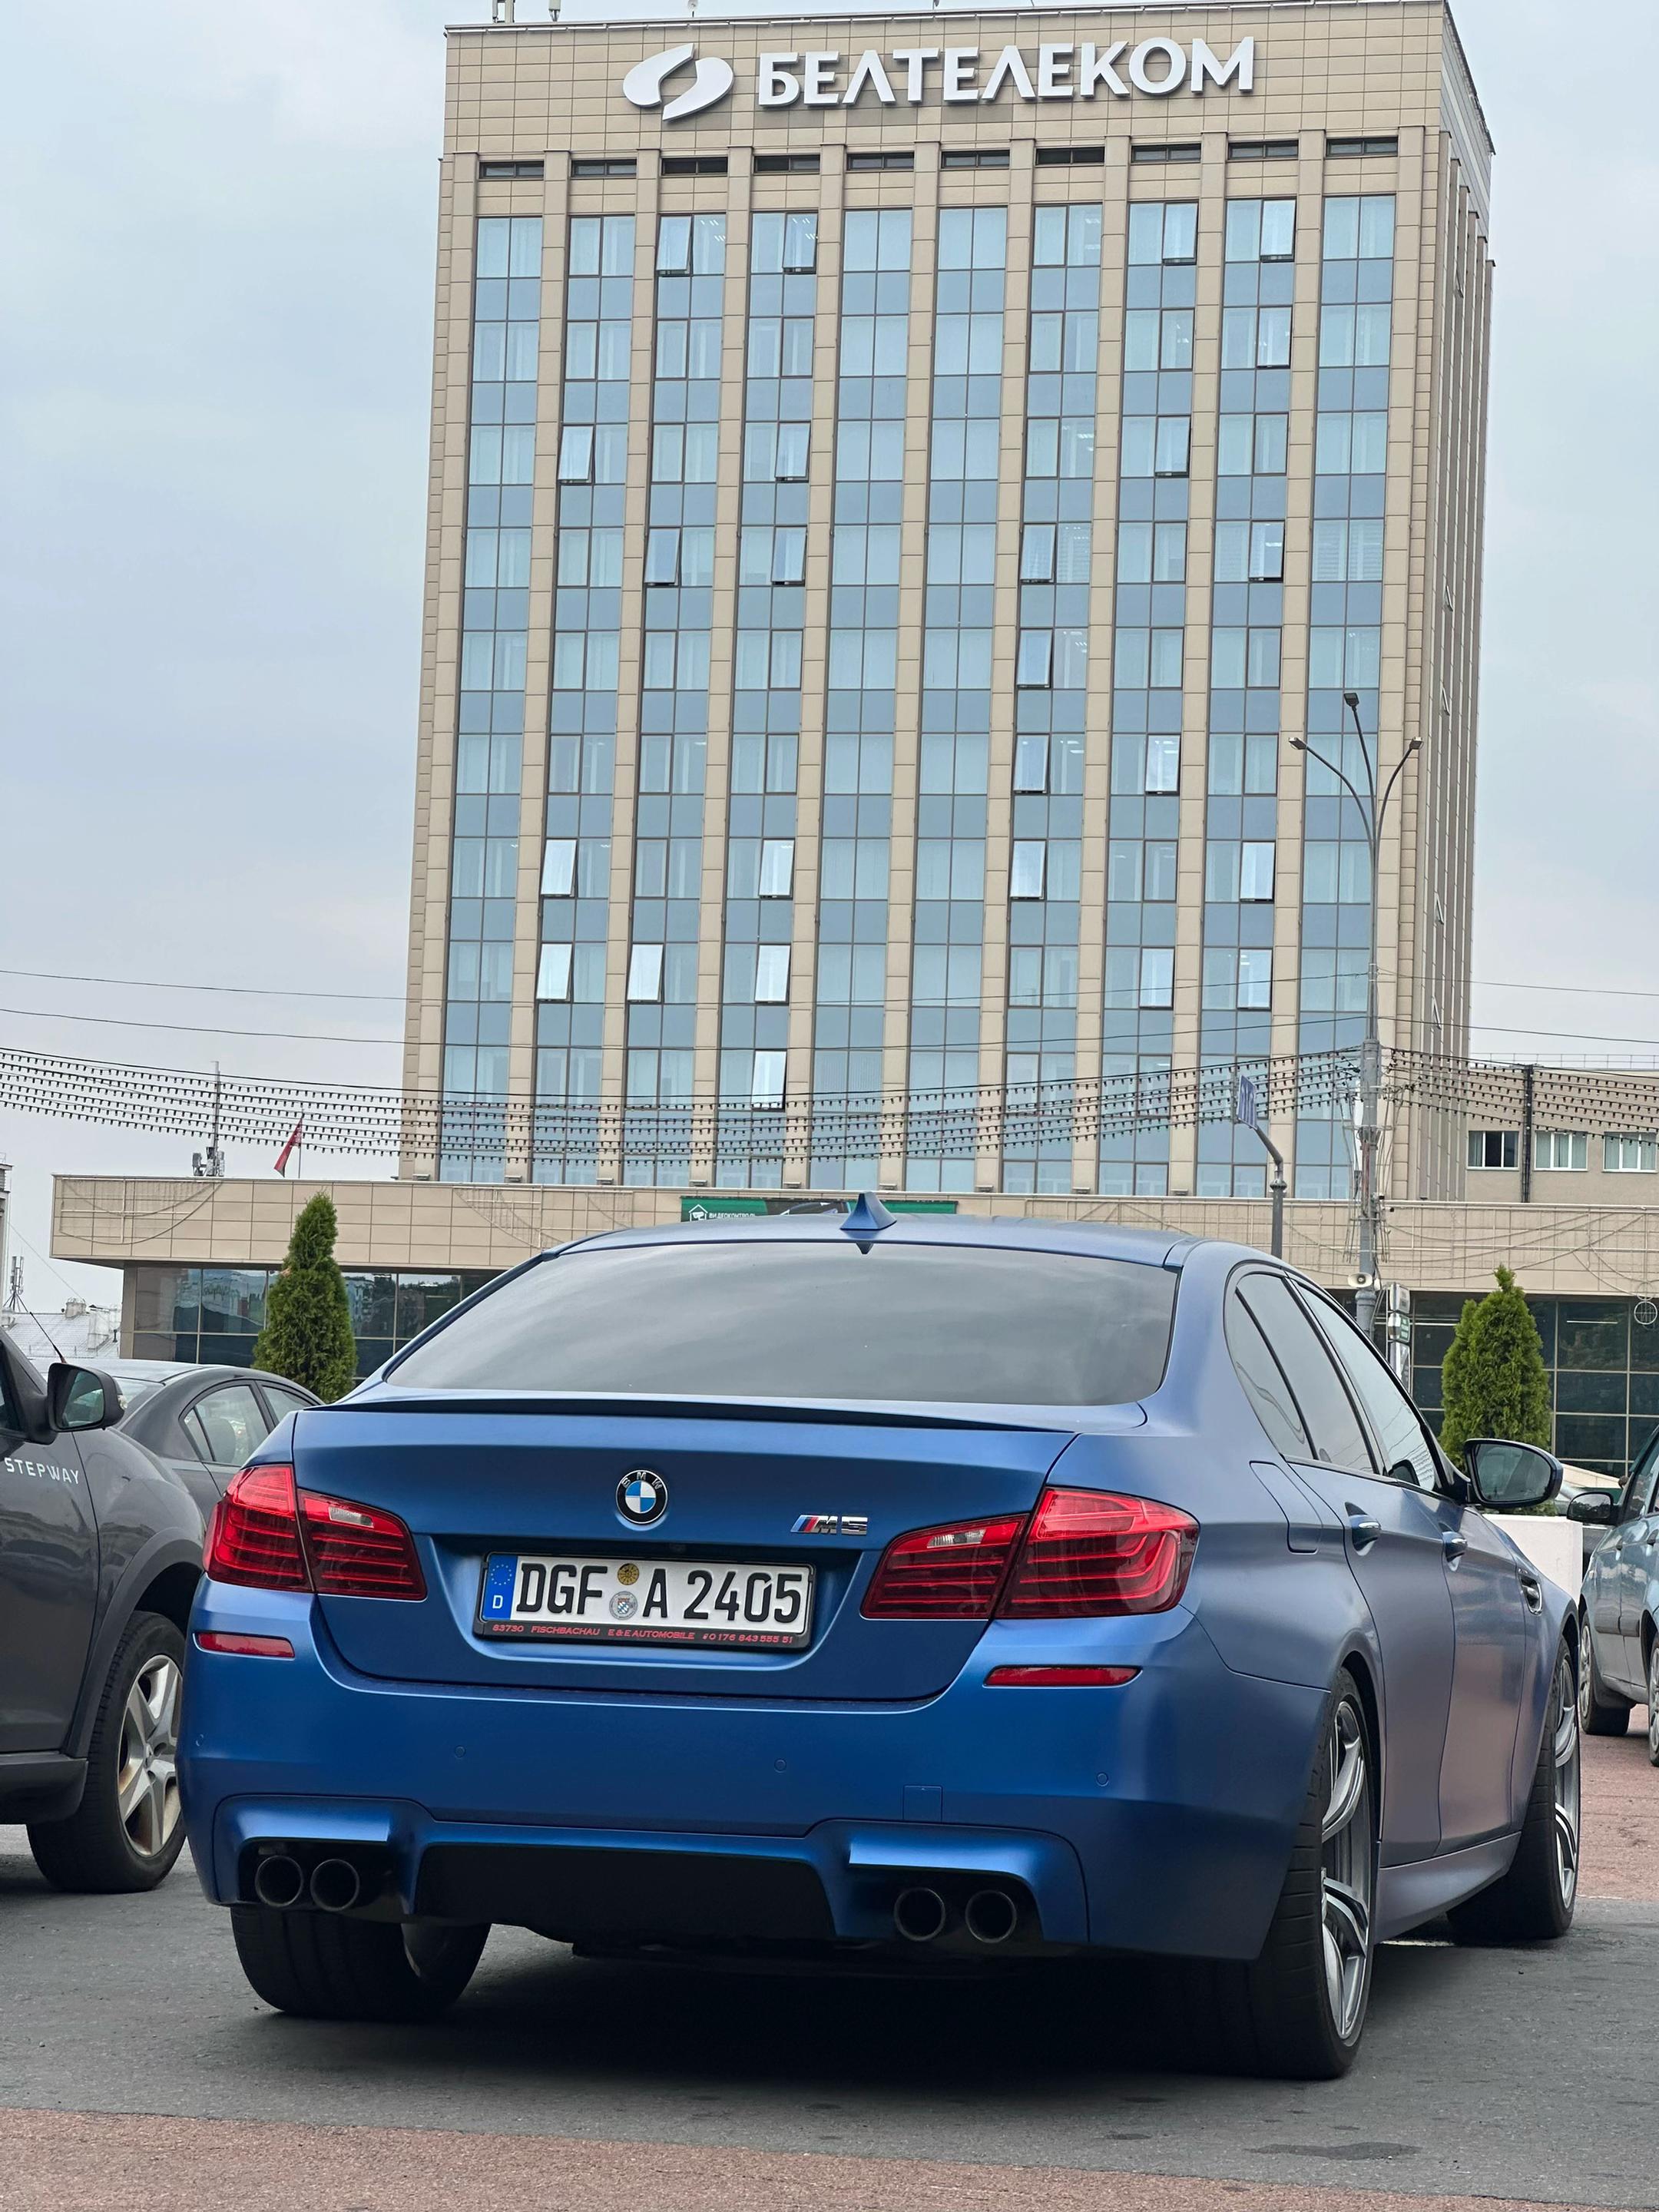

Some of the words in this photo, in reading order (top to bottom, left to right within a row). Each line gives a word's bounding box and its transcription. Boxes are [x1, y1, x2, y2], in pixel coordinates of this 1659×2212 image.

[758, 36, 1253, 108] БЕЛТЕЛЕКОМ
[4, 1457, 79, 1484] STEPWAY
[621, 1471, 663, 1490] BMW
[492, 1594, 503, 1609] D
[517, 1563, 608, 1614] DGF
[642, 1568, 668, 1618] A
[684, 1570, 802, 1624] 2405
[531, 1625, 601, 1636] FISCHBACHAU
[631, 1630, 695, 1640] AUTOMOBILE
